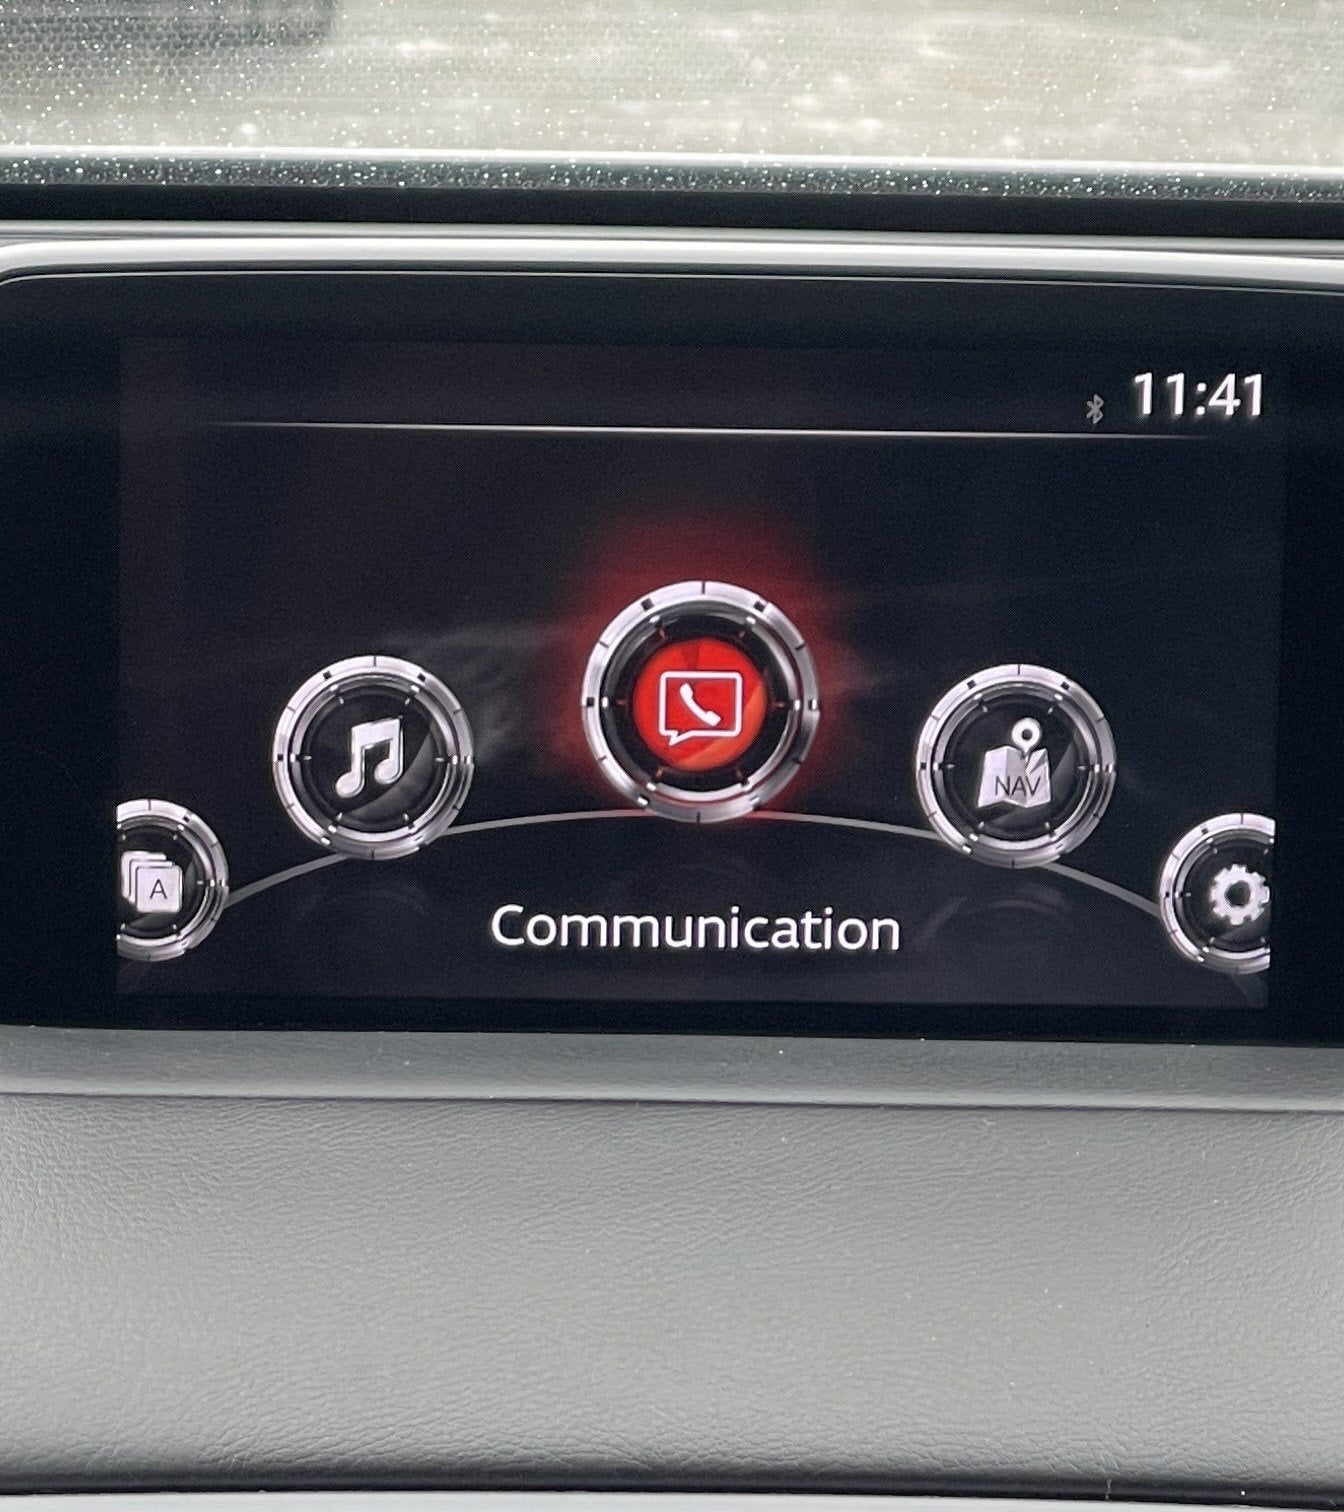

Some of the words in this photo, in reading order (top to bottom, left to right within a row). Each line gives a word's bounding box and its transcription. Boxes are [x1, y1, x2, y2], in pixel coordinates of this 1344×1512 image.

[1132, 370, 1265, 420] 11:41
[994, 775, 1041, 796] NAV
[149, 878, 168, 899] A
[490, 903, 902, 953] Communication
